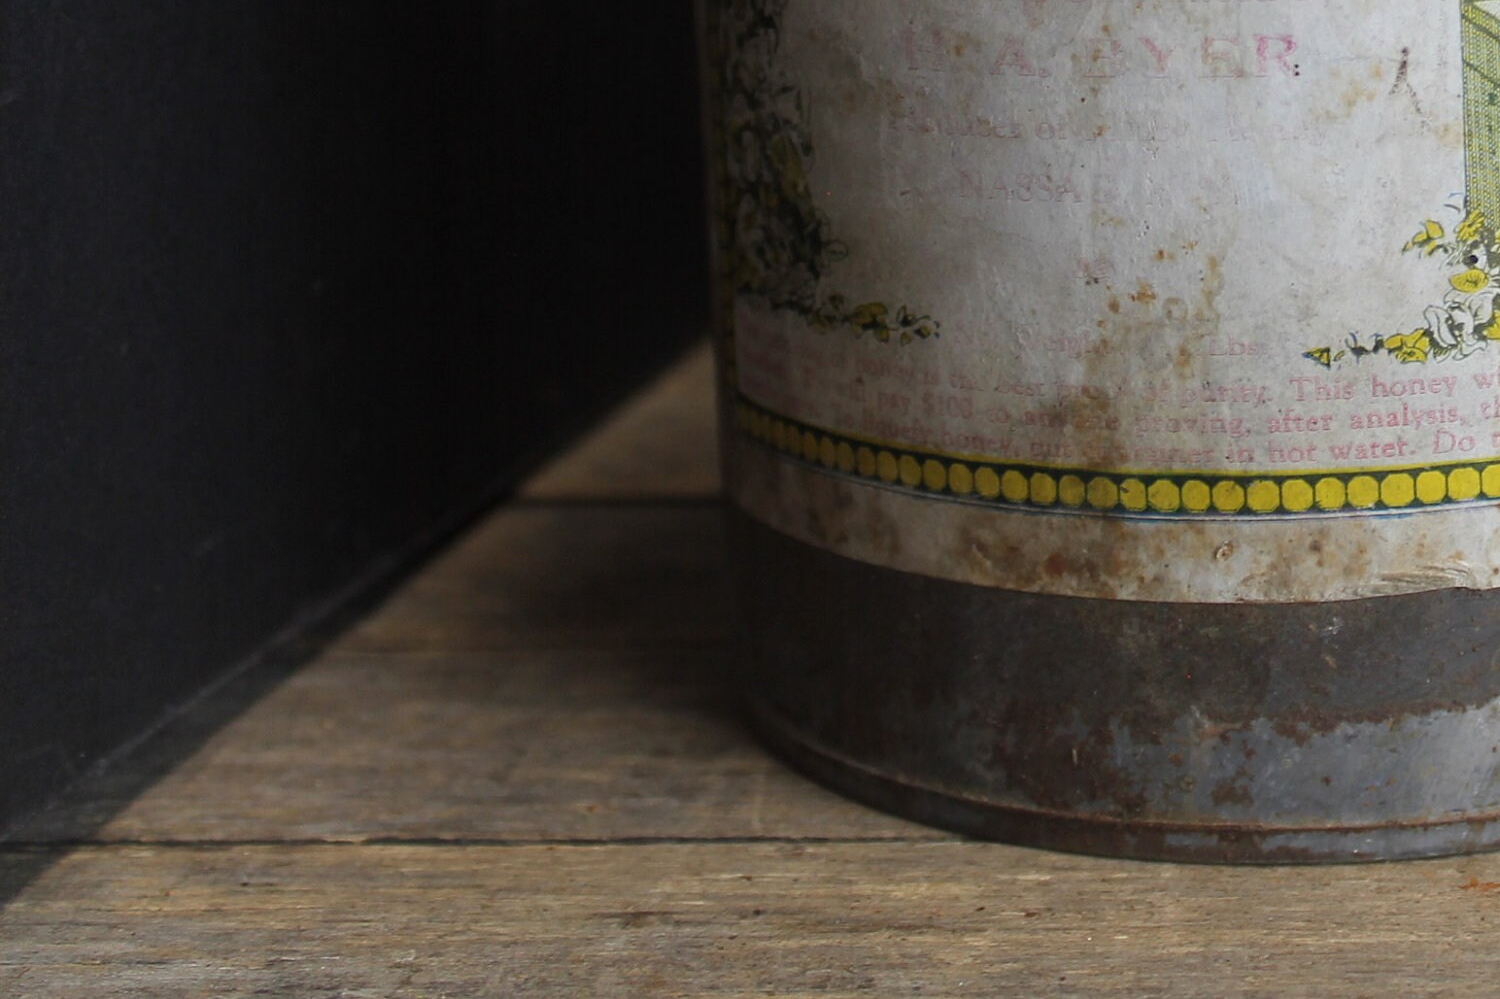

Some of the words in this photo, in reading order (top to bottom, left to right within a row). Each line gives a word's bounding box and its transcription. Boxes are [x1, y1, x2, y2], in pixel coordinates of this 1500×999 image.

[1289, 374, 1354, 403] This
[1370, 371, 1459, 399] honey
[1133, 414, 1252, 441] proving,
[1266, 409, 1334, 434] after
[1349, 401, 1467, 431] analysis,
[1224, 441, 1256, 465] in
[1267, 438, 1319, 464] hot
[1328, 438, 1418, 462] water.
[1432, 430, 1477, 455] Do
